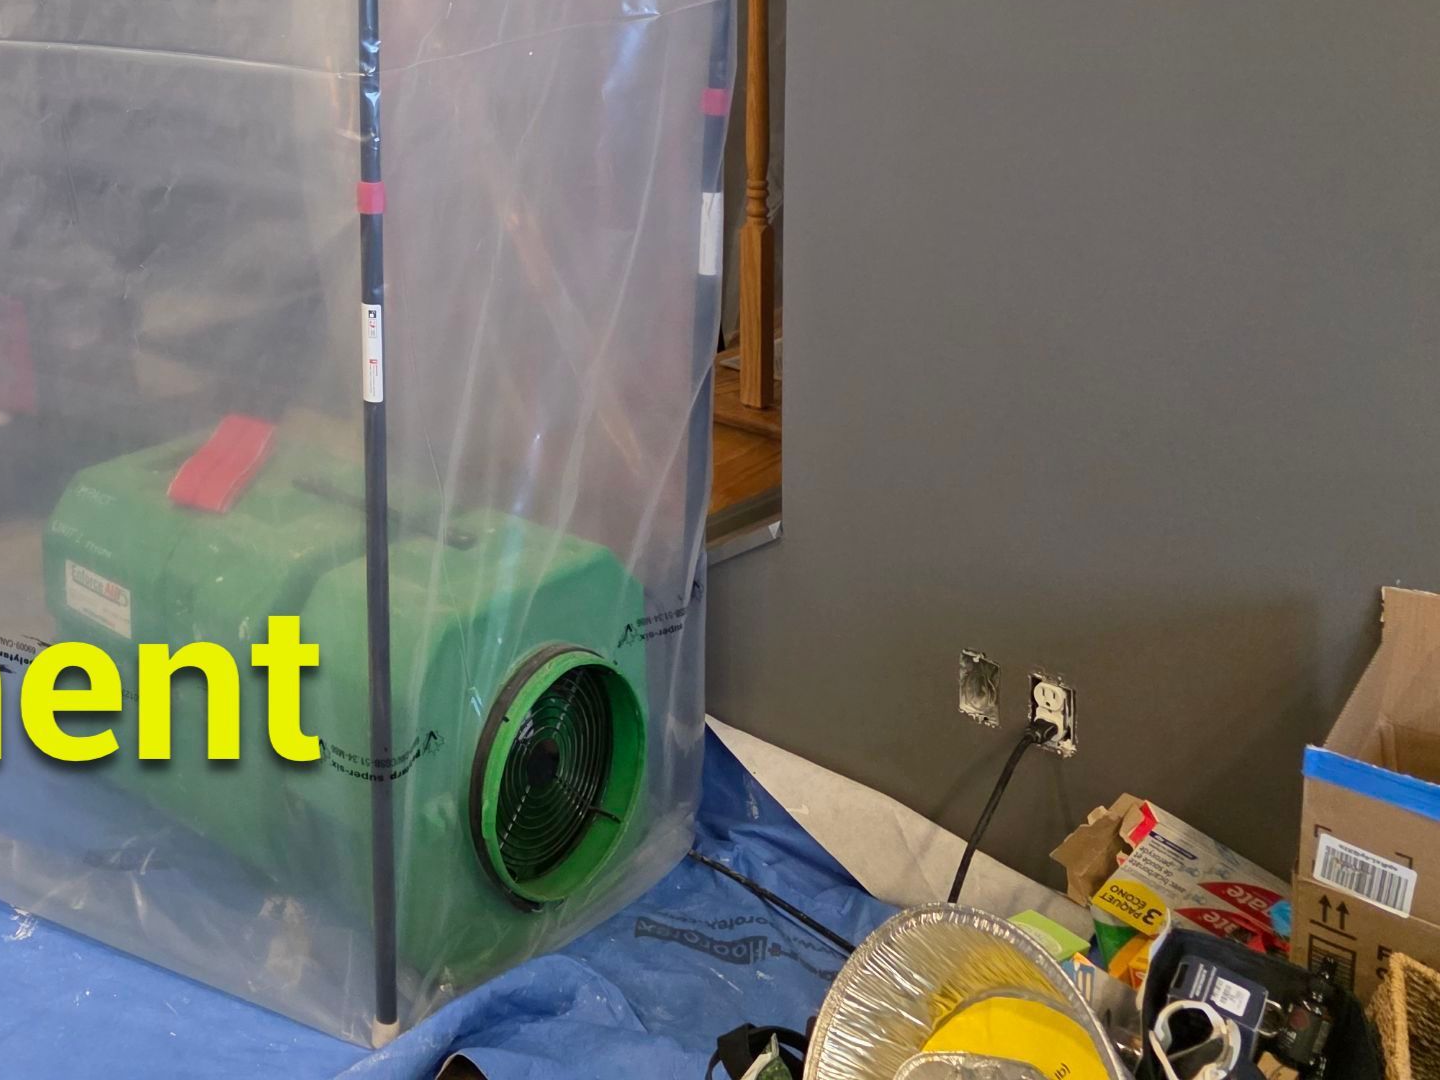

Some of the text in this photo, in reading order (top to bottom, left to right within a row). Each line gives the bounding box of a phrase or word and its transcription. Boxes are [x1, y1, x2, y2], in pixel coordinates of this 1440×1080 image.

[330, 759, 384, 783] super-six
[1099, 892, 1143, 920] PAQUET
[1109, 884, 1148, 909] ÉCONO
[1141, 907, 1163, 926] 3
